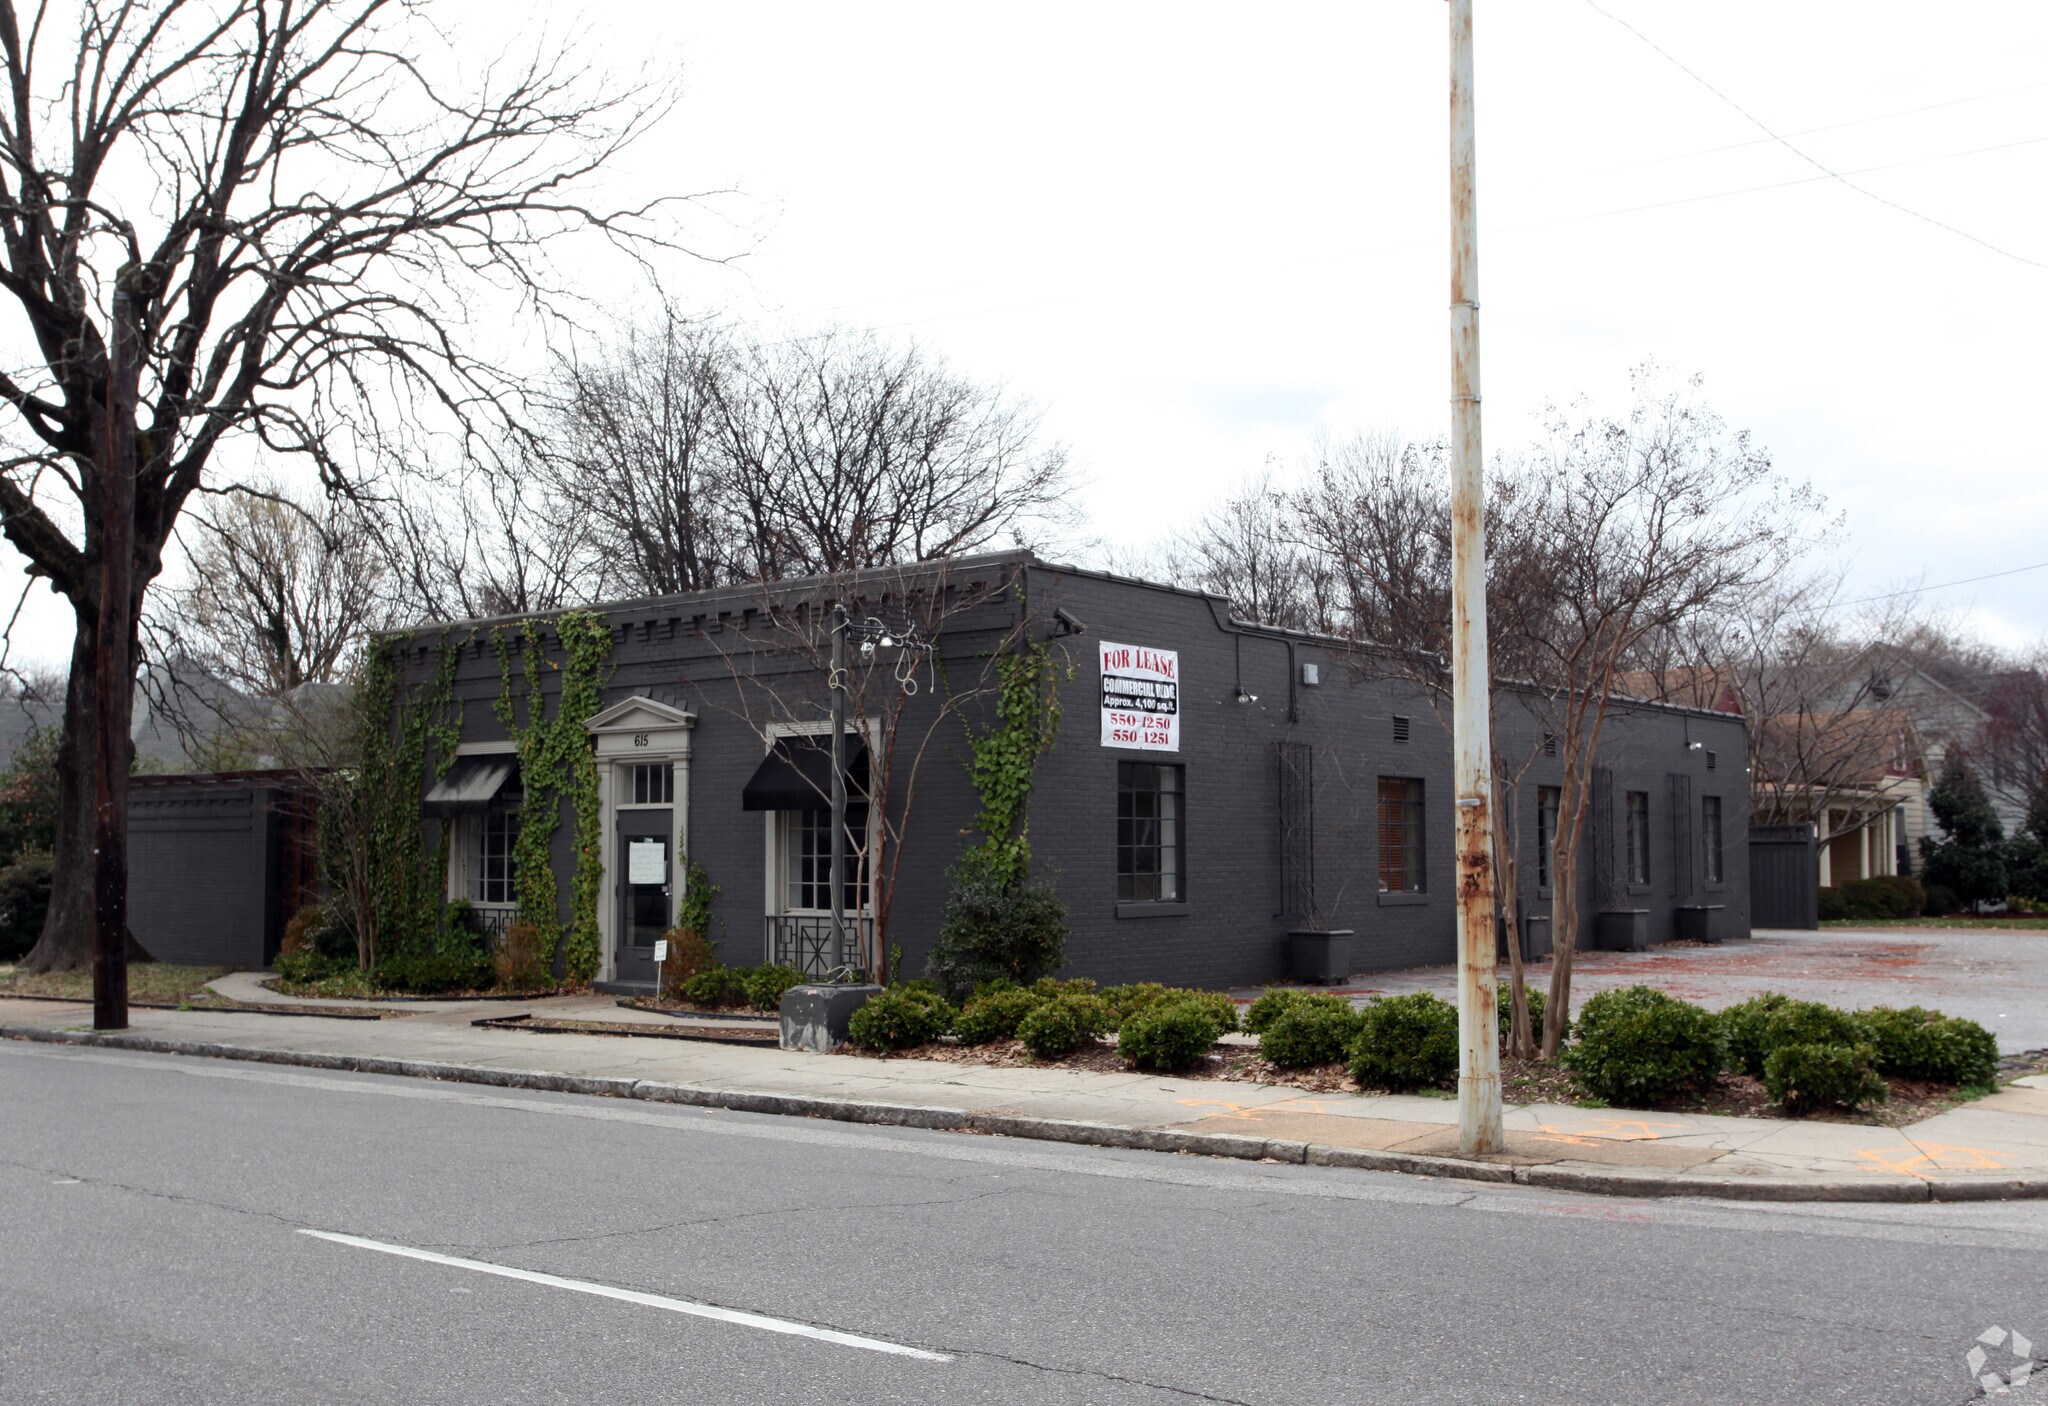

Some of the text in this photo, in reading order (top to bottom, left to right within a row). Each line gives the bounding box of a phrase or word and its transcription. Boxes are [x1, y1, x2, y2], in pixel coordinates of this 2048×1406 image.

[1104, 649, 1175, 679] FOR LEASE
[1103, 678, 1155, 697] COMMERCIAL
[1103, 695, 1134, 708] Approx.
[1135, 698, 1156, 710] 4,100
[1110, 713, 1171, 730] 550-1250
[634, 734, 648, 747] 615
[1112, 729, 1169, 745] 550-1251
